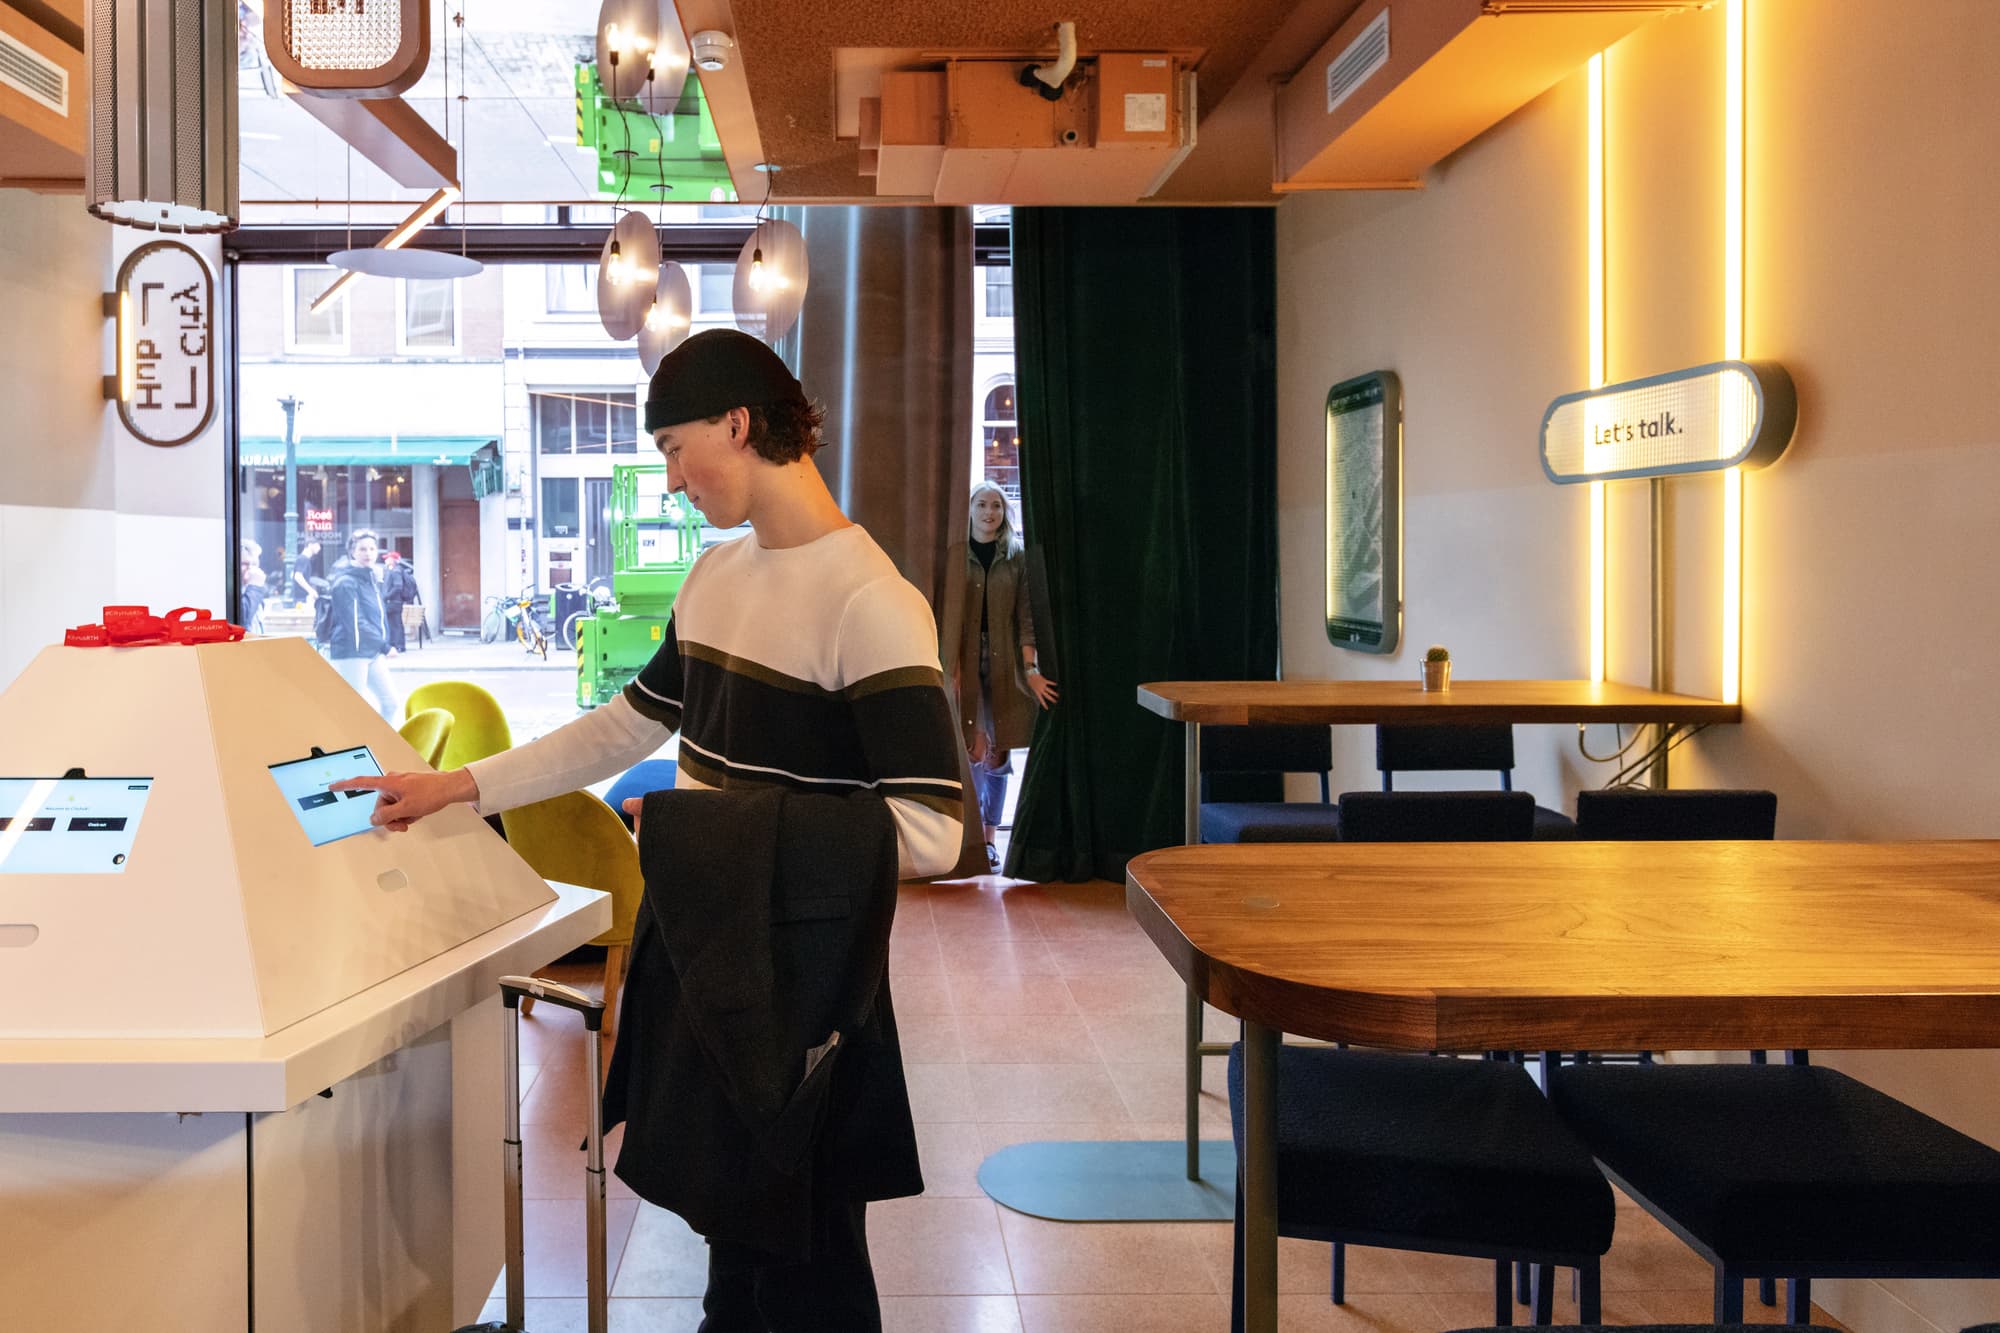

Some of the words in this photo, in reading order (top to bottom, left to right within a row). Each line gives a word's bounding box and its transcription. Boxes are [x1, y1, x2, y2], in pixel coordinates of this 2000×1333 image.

[1594, 423, 1634, 445] Let's
[1638, 411, 1683, 439] talk.
[307, 509, 333, 521] Rosé
[307, 521, 333, 531] Tuin
